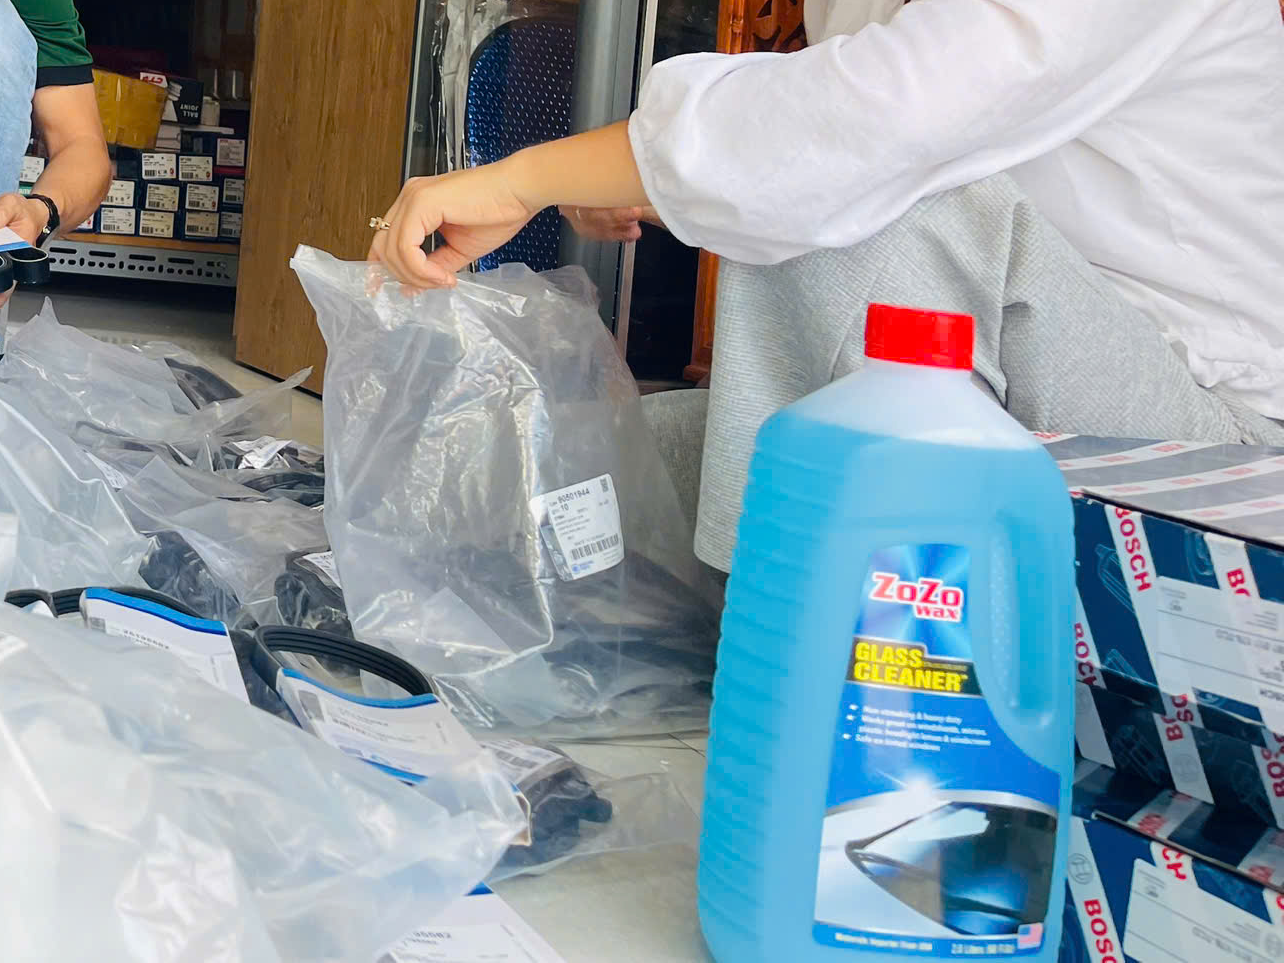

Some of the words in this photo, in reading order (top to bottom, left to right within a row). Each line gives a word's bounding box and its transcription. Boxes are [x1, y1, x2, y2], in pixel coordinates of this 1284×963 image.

[180, 103, 199, 111] JOINT
[1114, 507, 1152, 592] BOSCH
[872, 574, 962, 607] ZoZo
[915, 604, 958, 620] wax
[854, 642, 924, 668] GLASS
[853, 662, 962, 692] CLEANER
